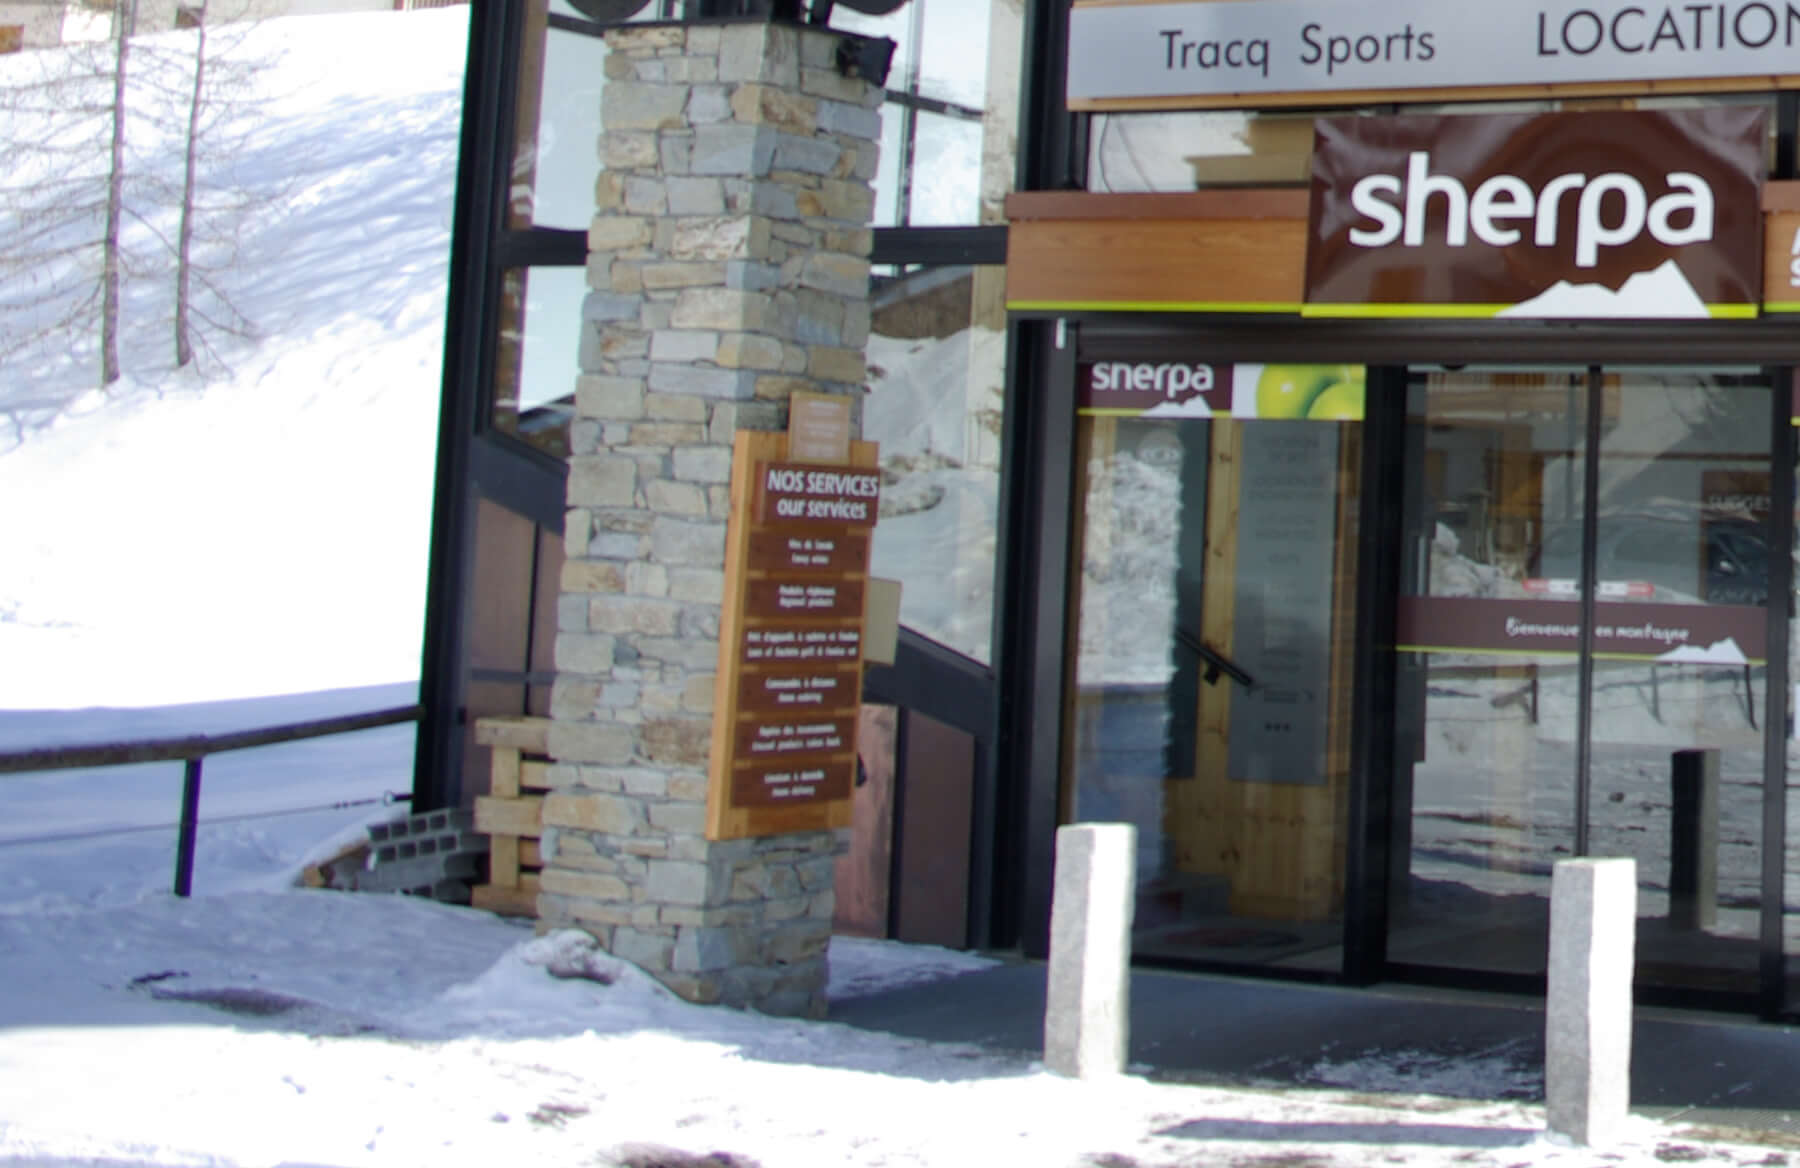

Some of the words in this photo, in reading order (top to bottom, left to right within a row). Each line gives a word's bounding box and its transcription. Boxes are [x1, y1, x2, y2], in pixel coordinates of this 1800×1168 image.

[1160, 30, 1269, 78] Tracq
[1300, 23, 1436, 75] Sports
[1348, 151, 1715, 268] sherpa
[767, 469, 804, 493] NOS
[806, 472, 878, 498] SERVICES
[777, 496, 806, 517] our
[807, 496, 867, 519] services
